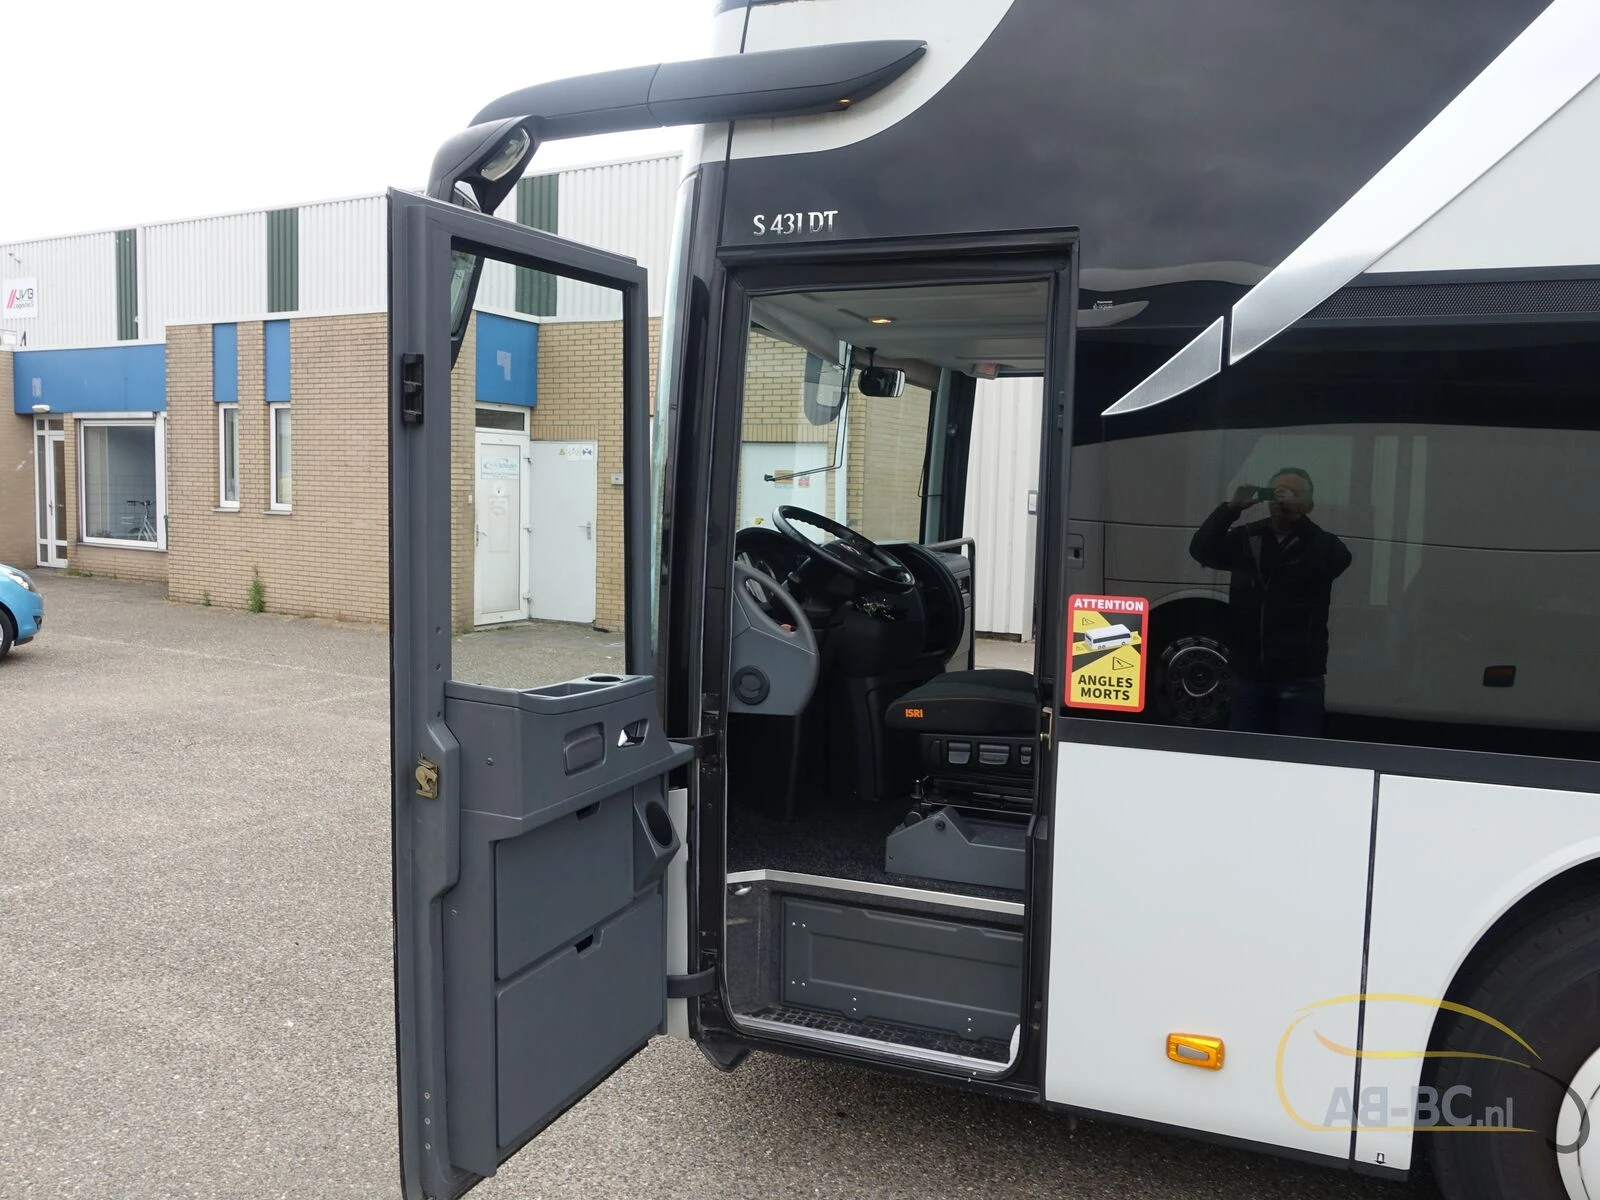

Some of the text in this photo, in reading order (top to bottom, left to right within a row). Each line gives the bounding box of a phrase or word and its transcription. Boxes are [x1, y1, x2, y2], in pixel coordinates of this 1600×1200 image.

[753, 210, 839, 236] S 431 DT
[1074, 598, 1144, 611] ATTENTION
[1078, 674, 1133, 689] ANGLES
[1080, 687, 1130, 701] MORTS
[905, 708, 924, 718] ISRI
